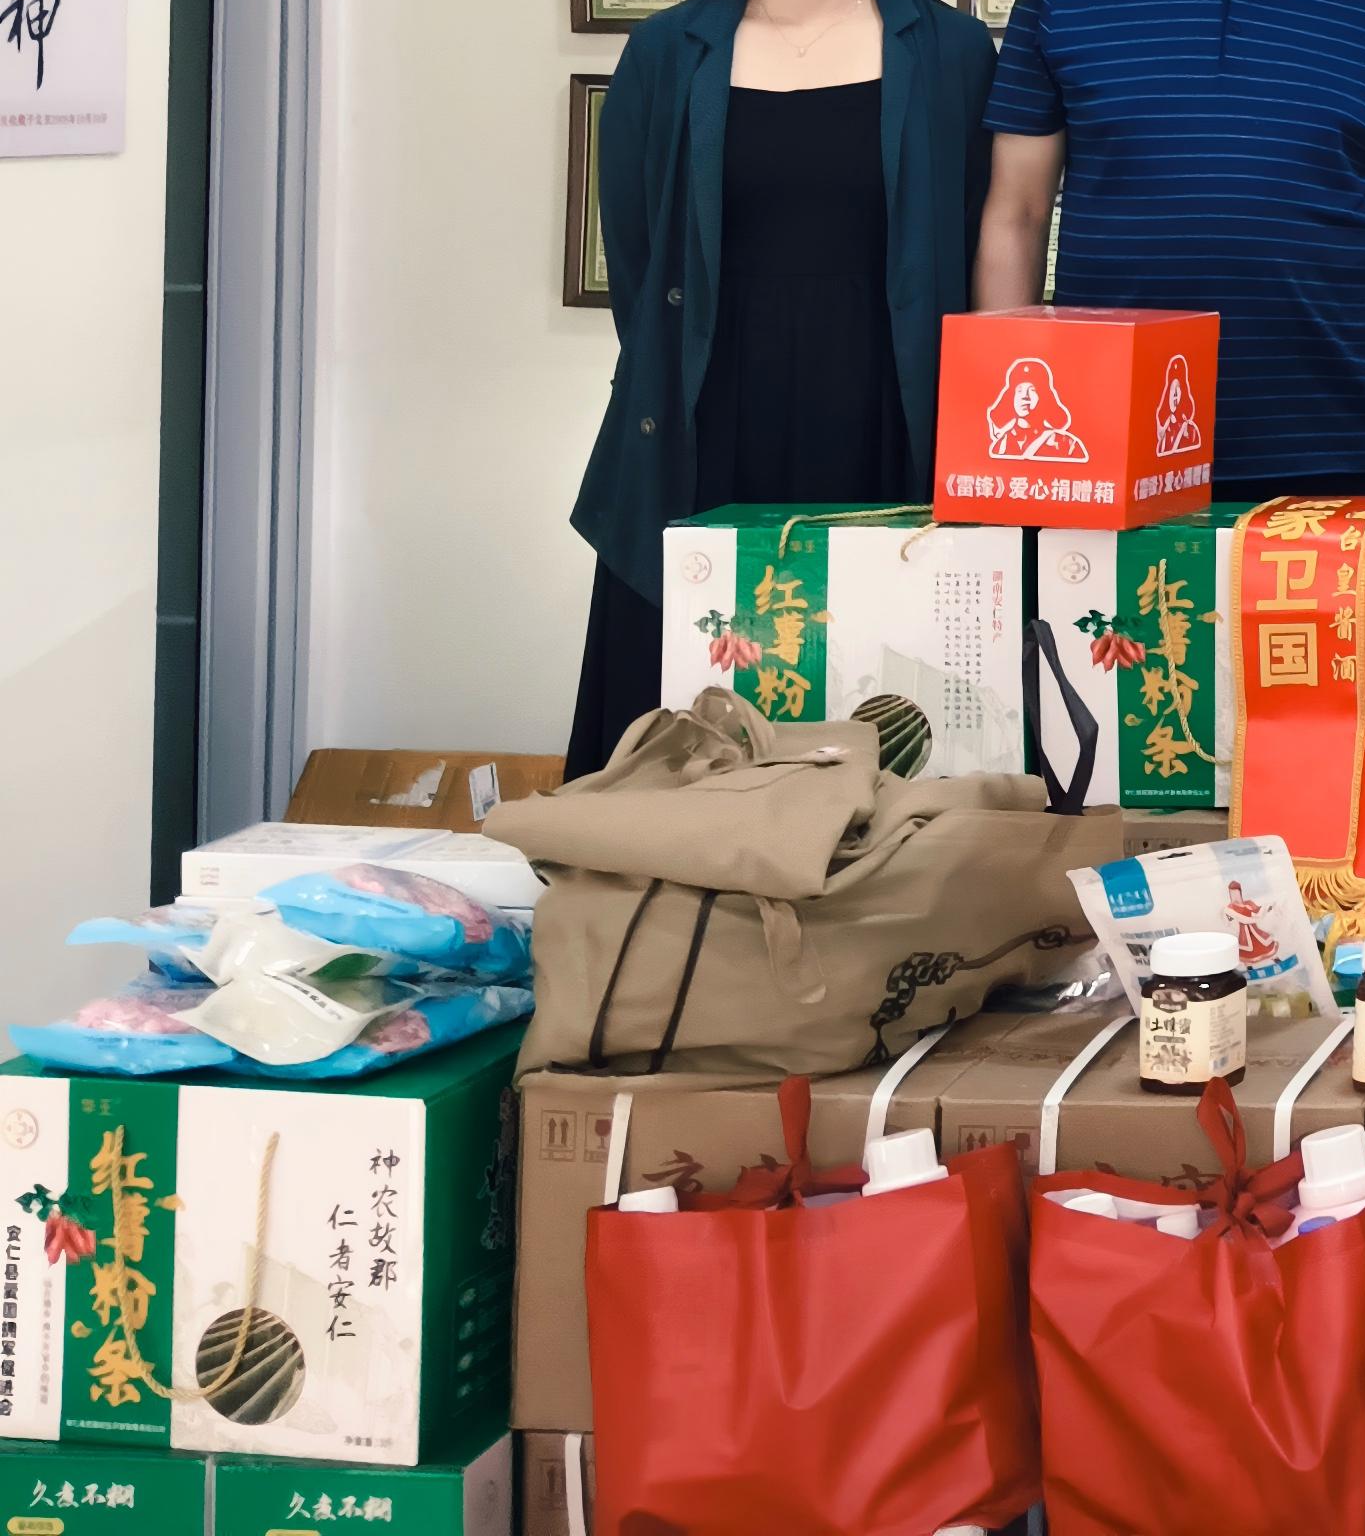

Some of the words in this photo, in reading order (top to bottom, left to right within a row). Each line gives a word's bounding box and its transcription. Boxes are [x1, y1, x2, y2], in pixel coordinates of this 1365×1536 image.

[945, 473, 1116, 505] 《雷锋》爱心捐赠箱
[1137, 565, 1202, 779] 红薯粉条
[88, 1130, 154, 1407] 红薯粉条
[325, 1202, 359, 1342] 仁者安仁
[367, 1148, 402, 1291] 神农故郡
